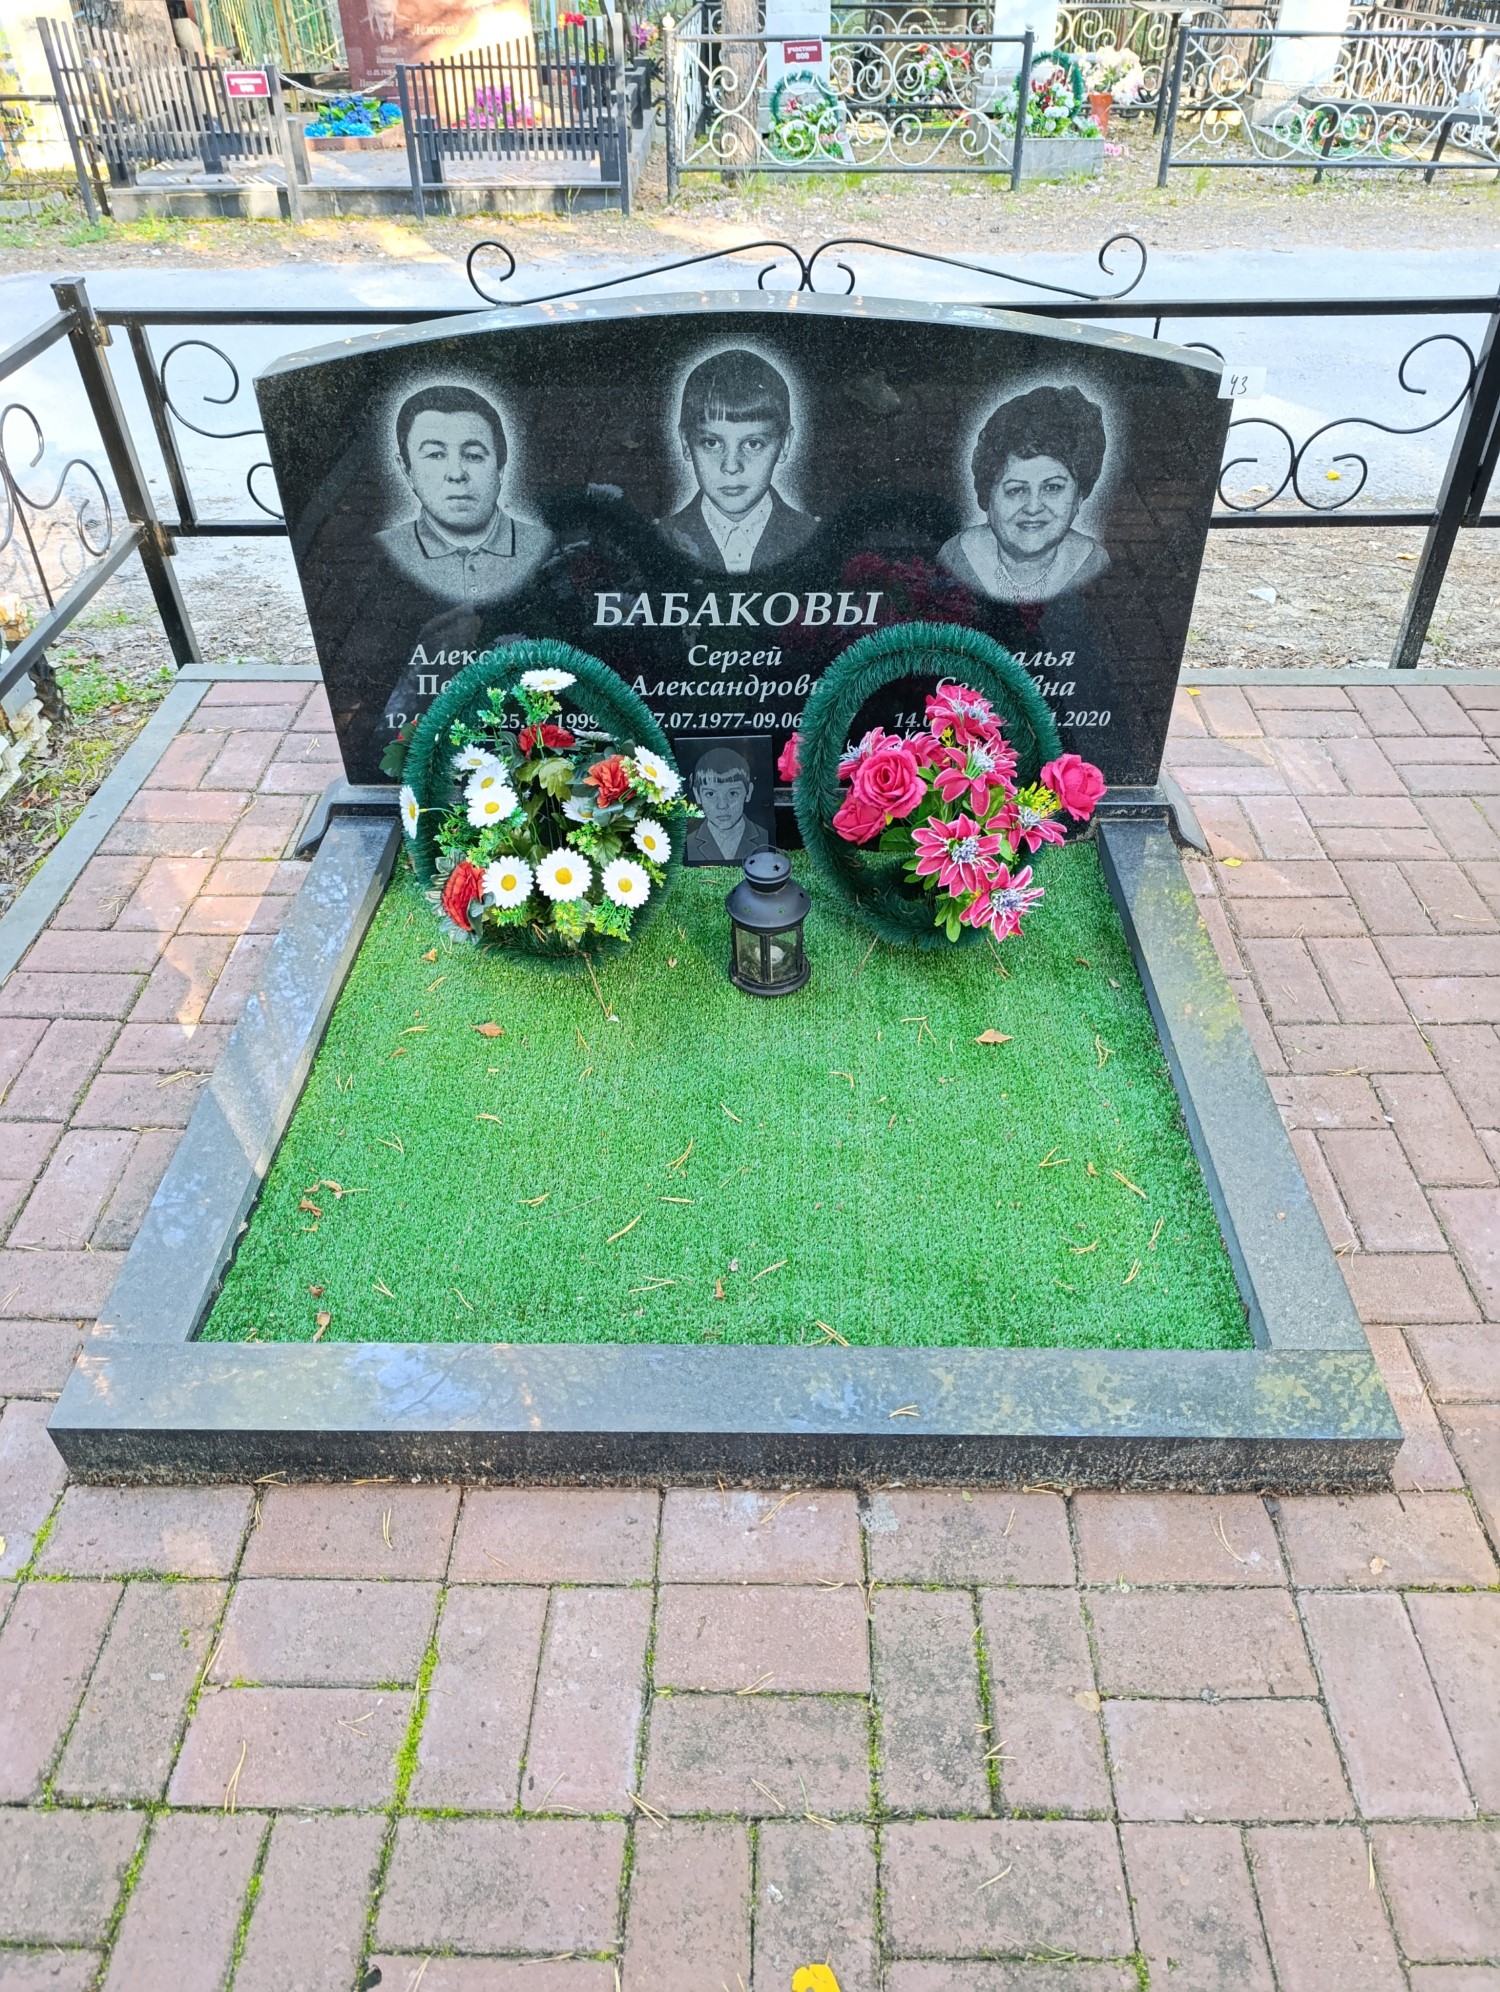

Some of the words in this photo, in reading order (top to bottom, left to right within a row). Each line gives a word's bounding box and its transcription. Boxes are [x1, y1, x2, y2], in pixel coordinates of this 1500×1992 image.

[1230, 374, 1249, 396] 43
[593, 591, 884, 627] БАБАКОВЫ
[407, 643, 493, 667] Алекс
[688, 644, 783, 673] Сергей
[1010, 650, 1077, 668] алья
[630, 674, 819, 703] Александрови
[652, 711, 805, 729] 7.07.1977-09.06
